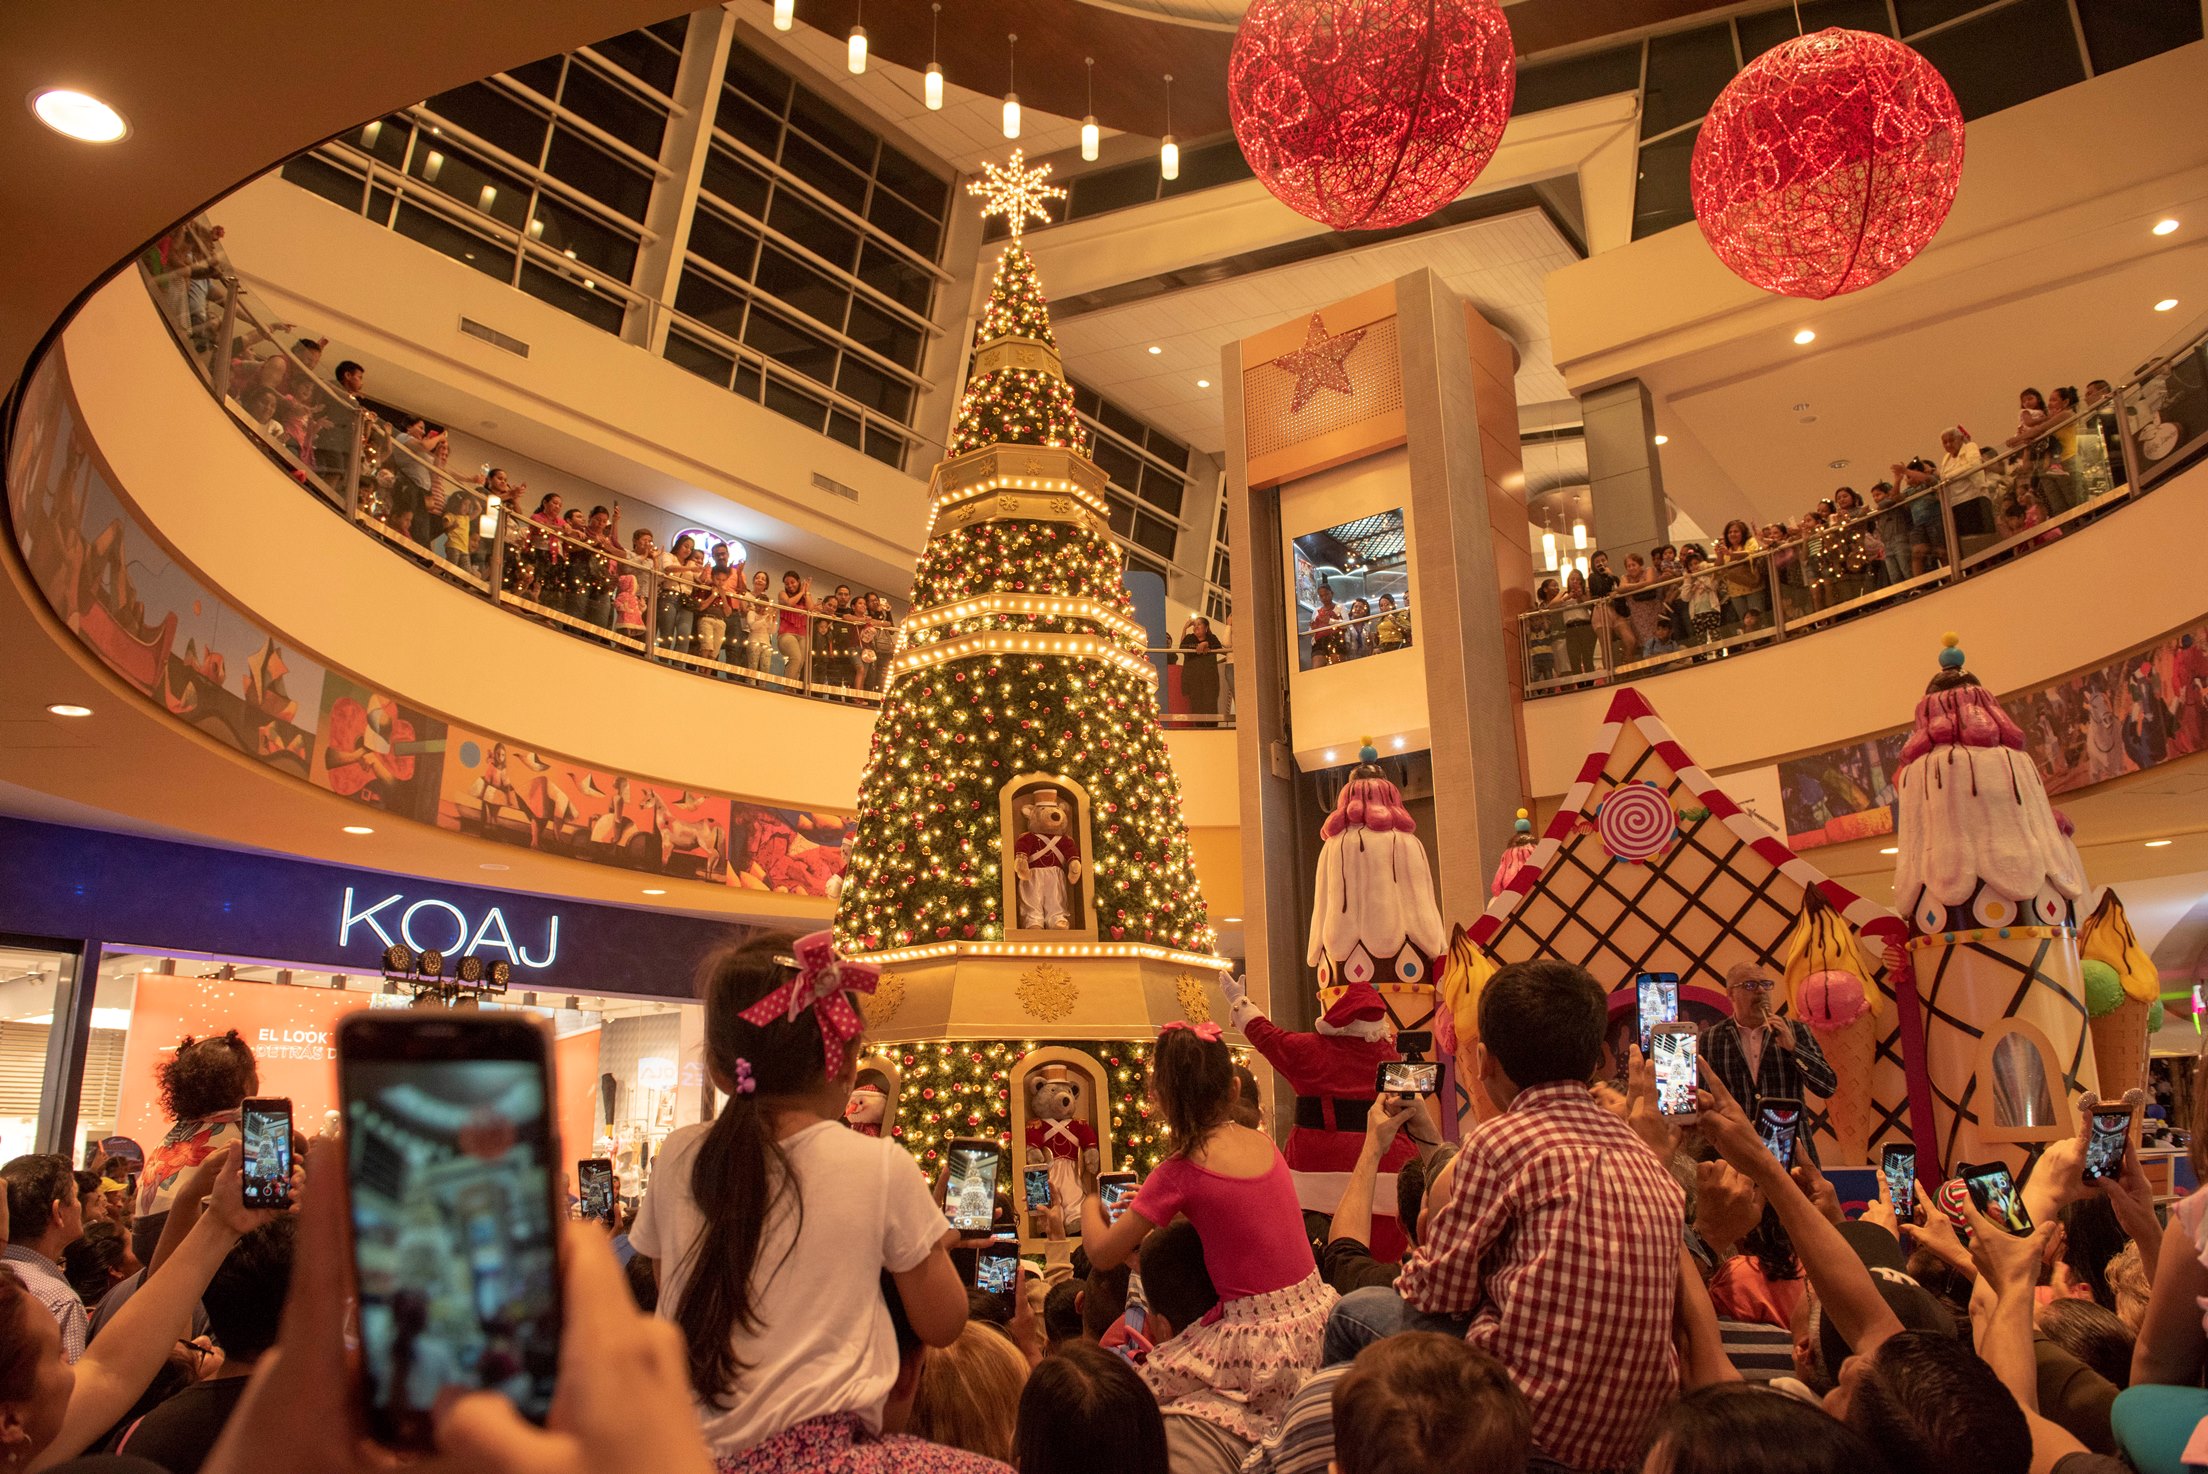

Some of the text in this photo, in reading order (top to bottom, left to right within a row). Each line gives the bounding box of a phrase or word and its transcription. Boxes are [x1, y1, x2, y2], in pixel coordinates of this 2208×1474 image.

[339, 887, 559, 968] KOAJ
[258, 1028, 328, 1044] EL LOOK
[256, 1043, 324, 1061] DETRÁS
